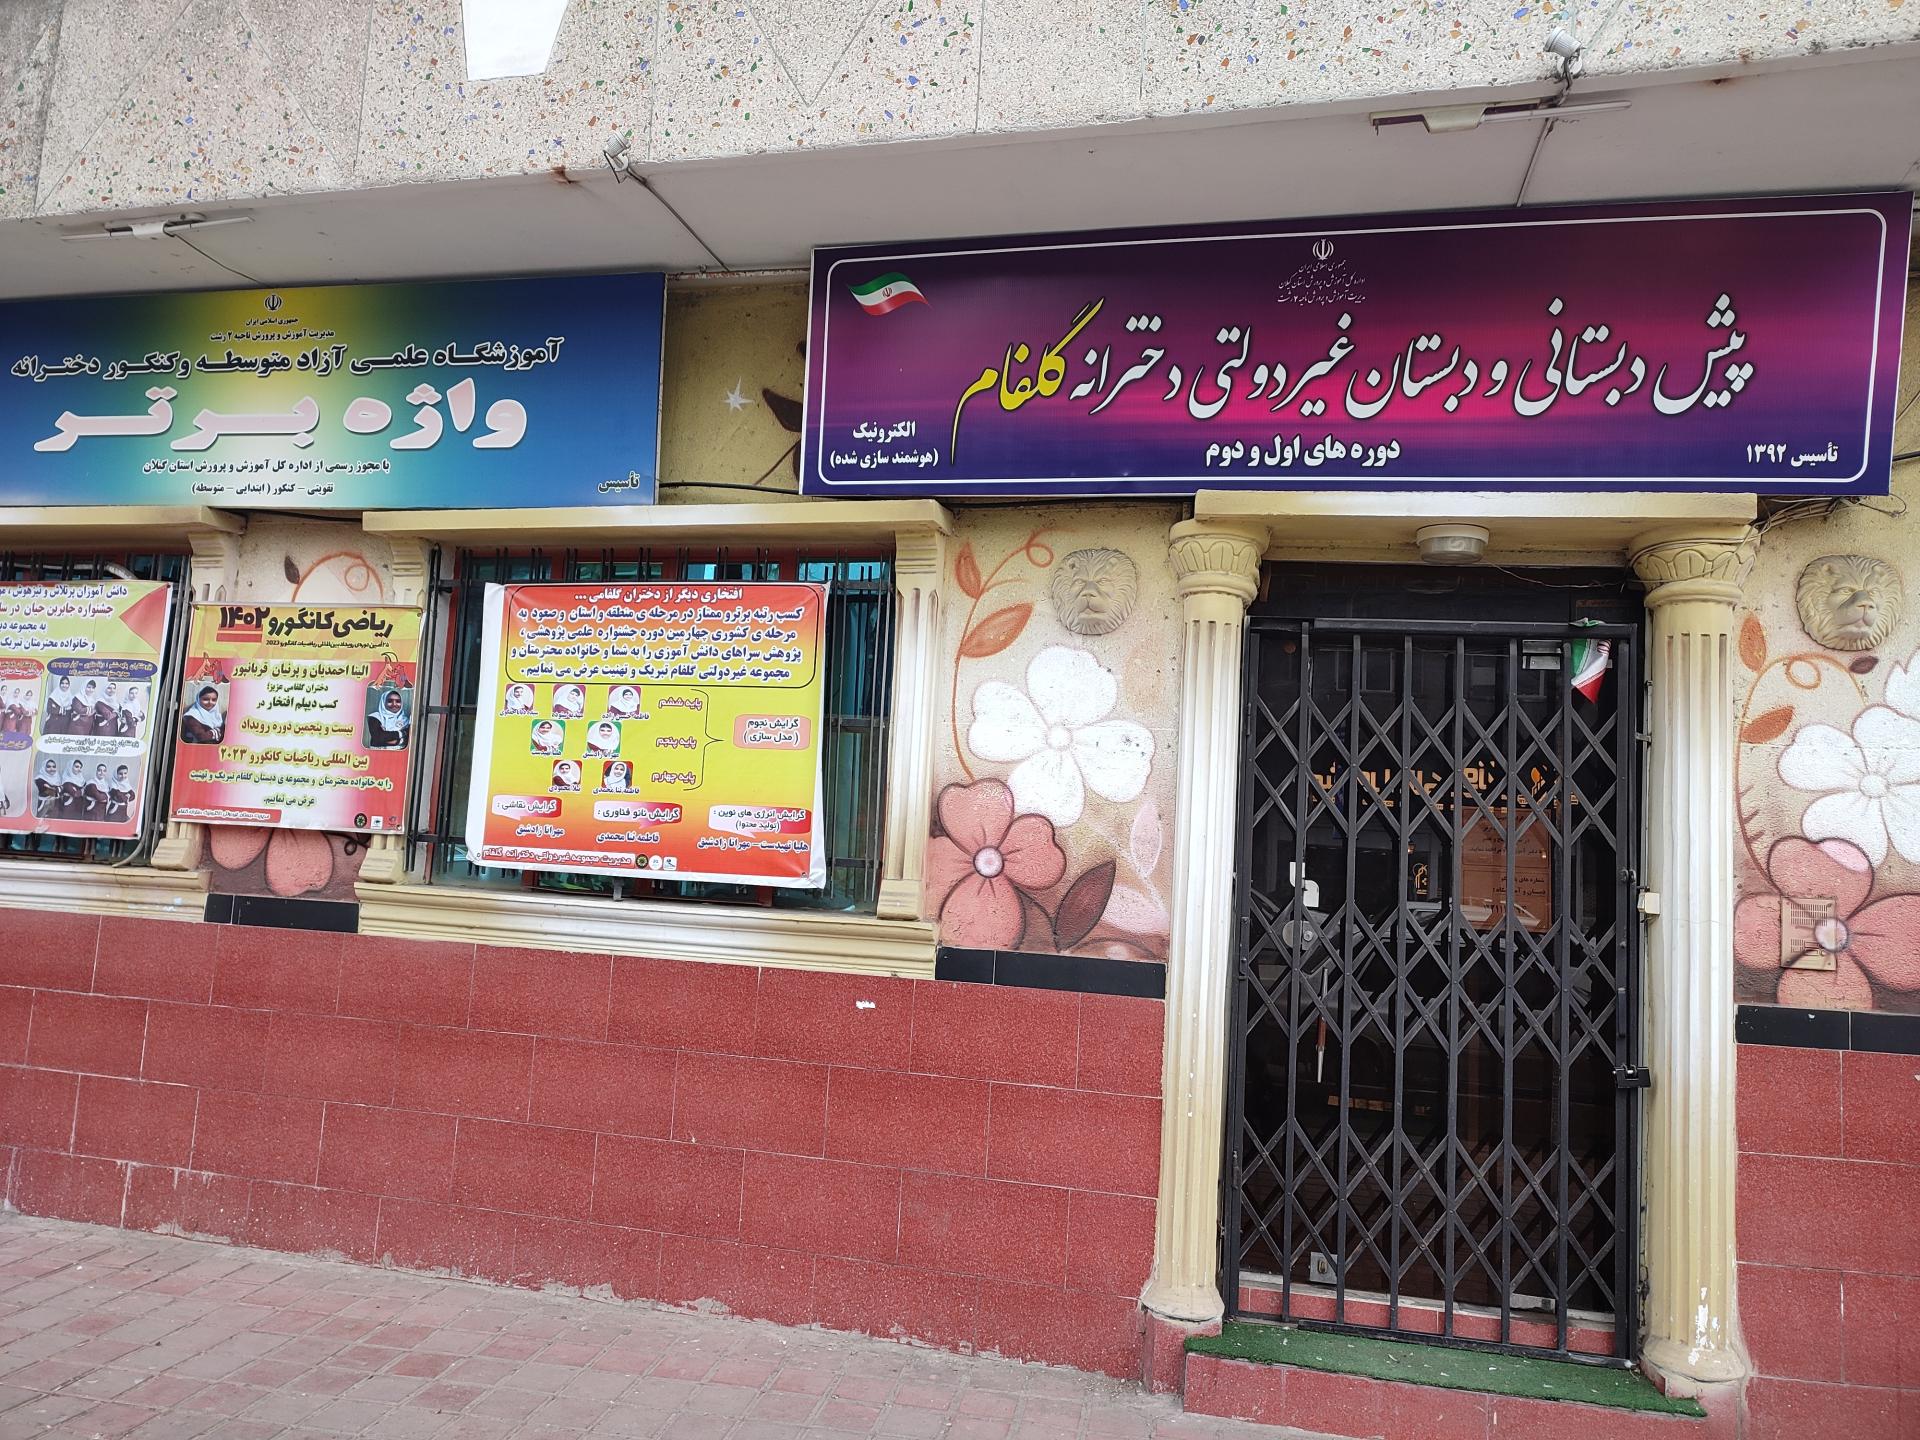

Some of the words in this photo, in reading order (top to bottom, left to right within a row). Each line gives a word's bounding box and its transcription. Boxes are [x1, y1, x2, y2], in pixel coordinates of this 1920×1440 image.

[210, 332, 227, 342] رشت
[252, 331, 276, 341] پرورش
[282, 329, 307, 341] آموزش
[308, 330, 335, 340] مدیریت
[296, 344, 347, 376] آزاد
[350, 344, 429, 375] علمی
[433, 336, 565, 371] آموزشگاه
[1513, 297, 1647, 417] دبستانی
[1652, 293, 1754, 415] پیش
[11, 354, 101, 382] دخترانه
[196, 349, 292, 377] متوسطه
[1069, 314, 1182, 415] دخترانه
[950, 297, 1107, 466] گلفام
[1345, 333, 1478, 419] دبستان
[1483, 358, 1508, 397] و
[343, 377, 527, 450] واژه
[853, 420, 916, 443] الکترونیک
[1206, 440, 1244, 467] دوم
[1248, 445, 1260, 467] و
[1264, 434, 1300, 467] اول
[1303, 434, 1347, 467] های
[1351, 440, 1400, 467] دوره
[1745, 442, 1787, 464] ۱۳۹۲
[1790, 441, 1838, 468] تأسیس
[830, 450, 858, 468] شده)
[860, 450, 889, 469] سازی
[892, 448, 939, 468] (هوشمند
[143, 459, 167, 474] گیلان
[168, 460, 194, 474] استان
[195, 460, 227, 475] پرورش
[235, 459, 272, 474] آموزش
[272, 460, 287, 472] کل
[288, 460, 313, 473] اداره
[314, 459, 323, 474] از
[325, 463, 353, 475] رسمی
[356, 461, 382, 475] مجوز
[381, 459, 390, 475] با
[273, 483, 296, 496] کنکور
[306, 484, 334, 497] تقویتی
[76, 584, 105, 599] آموزان
[105, 585, 128, 599] دانش
[588, 588, 622, 602] گلفامی
[623, 588, 660, 603] دختران
[664, 589, 673, 603] از
[674, 588, 699, 604] دیگر
[700, 587, 743, 602] افتخاری
[9, 605, 20, 616] در
[23, 602, 45, 616] حیان
[77, 602, 114, 617] جشنواره
[518, 609, 528, 621] به
[531, 610, 557, 622] صعود
[569, 607, 596, 620] استان
[606, 607, 634, 620] منطقه
[648, 607, 679, 622] مرحله
[680, 610, 694, 622] در
[696, 607, 721, 622] ممتاز
[753, 608, 774, 623] رتبه
[776, 608, 802, 622] کسب
[220, 606, 271, 629] ۱۴۰۲
[267, 607, 335, 637] کانگورو
[333, 609, 394, 639] ریاضی
[8, 623, 37, 634] مجموعه
[567, 626, 593, 640] علمی
[597, 626, 638, 640] جشنواره
[640, 627, 664, 641] دوره
[667, 626, 709, 642] چهارمین
[711, 626, 749, 642] کشوری
[764, 627, 796, 642] مرحله
[59, 638, 89, 651] خانواده
[518, 644, 563, 658] محترمتان
[611, 645, 628, 656] شما
[565, 645, 600, 659] خانواده
[643, 647, 652, 660] را
[654, 644, 688, 660] آموزی
[690, 646, 719, 660] دانش
[721, 646, 761, 662] سراهای
[762, 646, 801, 662] پژوهش
[309, 663, 349, 678] احمدیان
[555, 668, 571, 678] می
[577, 666, 599, 678] عرض
[601, 666, 628, 679] تهنیت
[638, 664, 668, 679] تبریک
[670, 664, 697, 679] گلفام
[750, 667, 790, 682] مجموعه
[305, 683, 329, 693] دختران
[256, 700, 266, 710] در
[267, 695, 294, 710] افتخار
[294, 696, 317, 711] دیپلم
[318, 699, 339, 709] کسب
[658, 696, 684, 708] ششم
[684, 698, 703, 711] پایه
[241, 719, 270, 734] رویداد
[272, 722, 292, 735] دوره
[293, 723, 322, 735] پنجمین
[331, 725, 354, 736] بیست
[747, 719, 768, 729] نجوم
[769, 718, 799, 730] گرایش
[656, 736, 679, 749] پنجم
[678, 736, 697, 749] پایه
[220, 747, 247, 760] ۲۰۲۳
[283, 752, 320, 767] ریاضیات
[321, 754, 351, 767] المللی
[352, 757, 368, 769] بین
[651, 771, 678, 784] چهارم
[677, 772, 697, 785] پایه
[502, 800, 526, 811] نقاشی
[527, 800, 557, 812] گرایش
[602, 808, 631, 820] فناوری
[632, 809, 647, 820] نانو
[648, 809, 679, 821] گرایش
[718, 808, 737, 818] نوین
[737, 809, 752, 818] های
[754, 810, 775, 820] انرژی
[777, 809, 805, 821] گرایش
[759, 821, 780, 833] (تولید
[597, 832, 625, 843] محمدی
[571, 852, 600, 864] مجموعه
[601, 854, 631, 866] مدیریت
